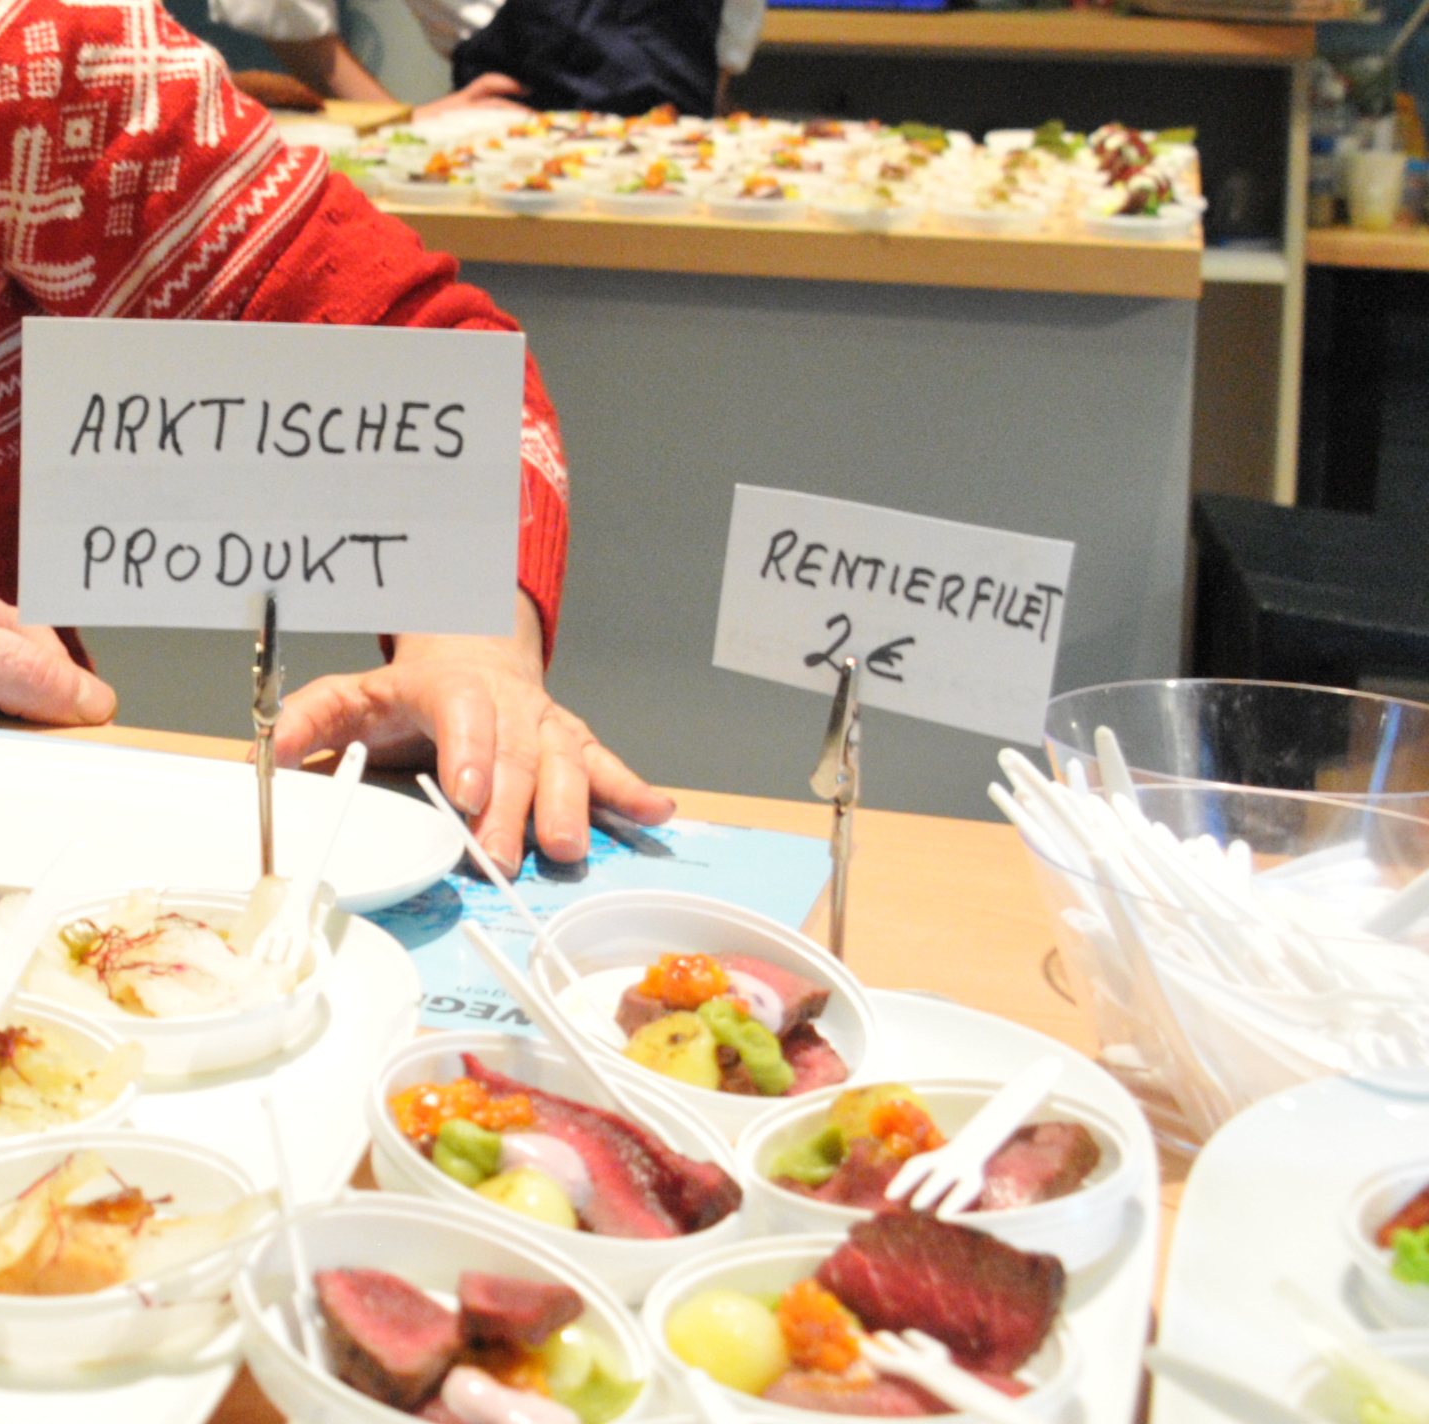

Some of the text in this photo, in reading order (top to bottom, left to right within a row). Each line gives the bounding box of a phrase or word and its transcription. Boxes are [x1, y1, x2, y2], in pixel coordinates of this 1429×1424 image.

[70, 393, 466, 458] ARKTISCHES
[83, 525, 409, 591] PRODUKT
[759, 529, 1064, 644] RENTIERFILET
